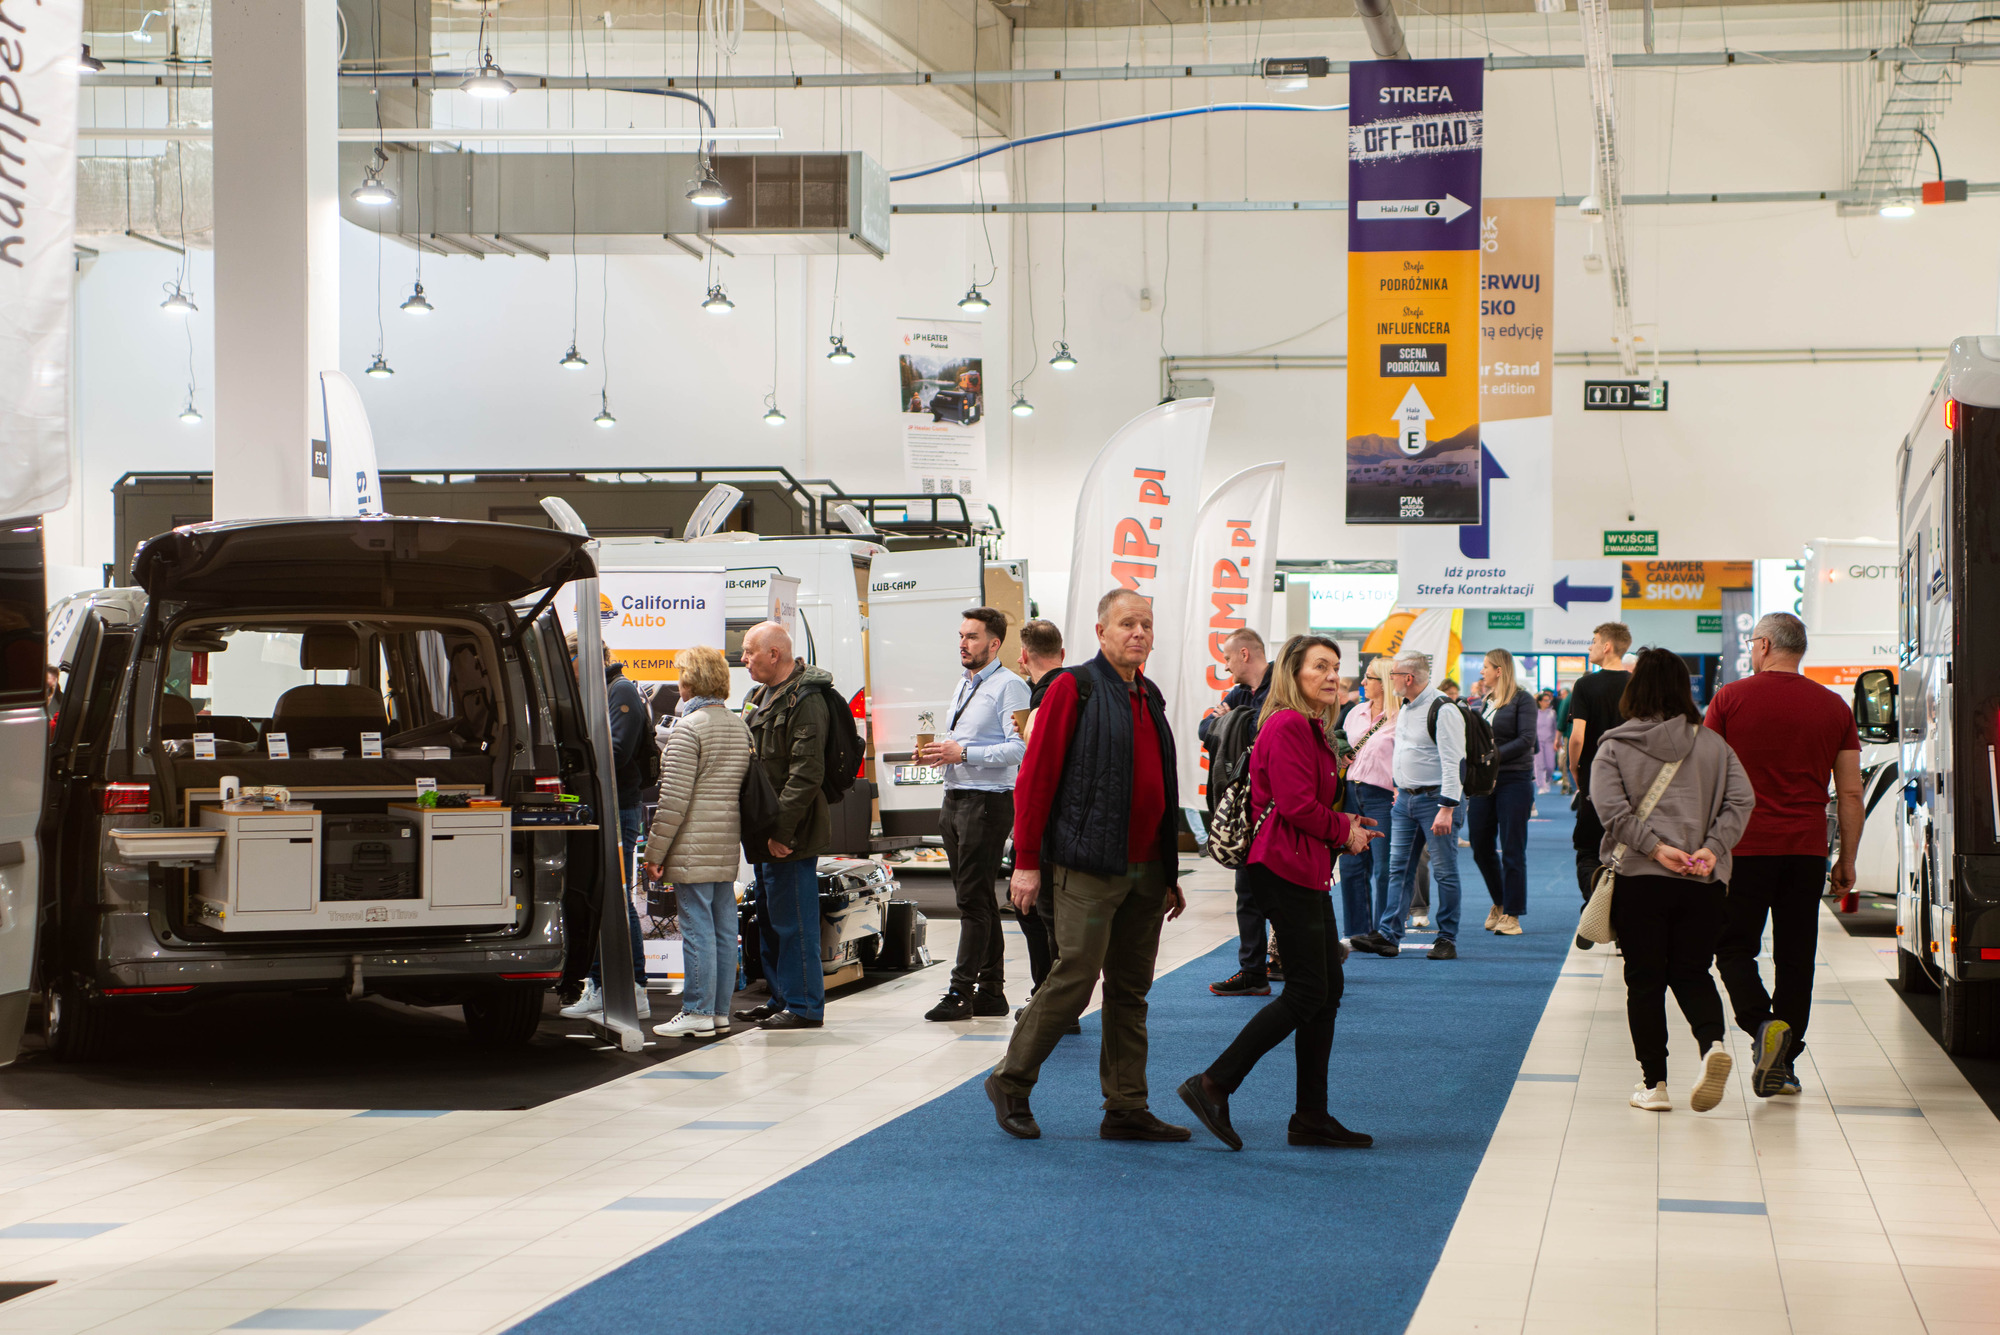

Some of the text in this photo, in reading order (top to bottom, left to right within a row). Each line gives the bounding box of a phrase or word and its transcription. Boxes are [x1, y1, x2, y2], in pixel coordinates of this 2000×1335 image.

[1379, 86, 1453, 103] STREFA
[1364, 119, 1468, 153] OFF-ROAD
[1381, 205, 1398, 213] Hala
[1429, 202, 1438, 214] F
[1403, 260, 1424, 273] Strefa
[1380, 276, 1448, 291] PODRÓŻNIKA
[1403, 306, 1424, 319] Strefa
[1377, 322, 1450, 335] INFLUENCERA
[1500, 323, 1544, 341] edycję
[913, 333, 948, 342] JP HEATER
[1399, 348, 1428, 359] SCENA
[1386, 360, 1440, 373] PODRÓŻNIKA
[1494, 361, 1540, 376] Stand
[1491, 382, 1536, 395] edition
[1408, 432, 1419, 449] E
[1400, 496, 1424, 505] PTAK
[1400, 509, 1424, 517] EXPO
[1607, 532, 1655, 544] WYJŚCIE
[1444, 566, 1506, 580] Idź prosto
[1646, 561, 1704, 572] CAMPER
[1646, 573, 1704, 583] CARAVAN
[872, 580, 917, 592] LUB-CAMP
[1416, 583, 1535, 597] Strefa Kontraktacji
[1646, 584, 1704, 600] SHOW
[621, 595, 706, 610] California
[621, 612, 666, 627] Auto
[328, 908, 419, 922] Travel Time
